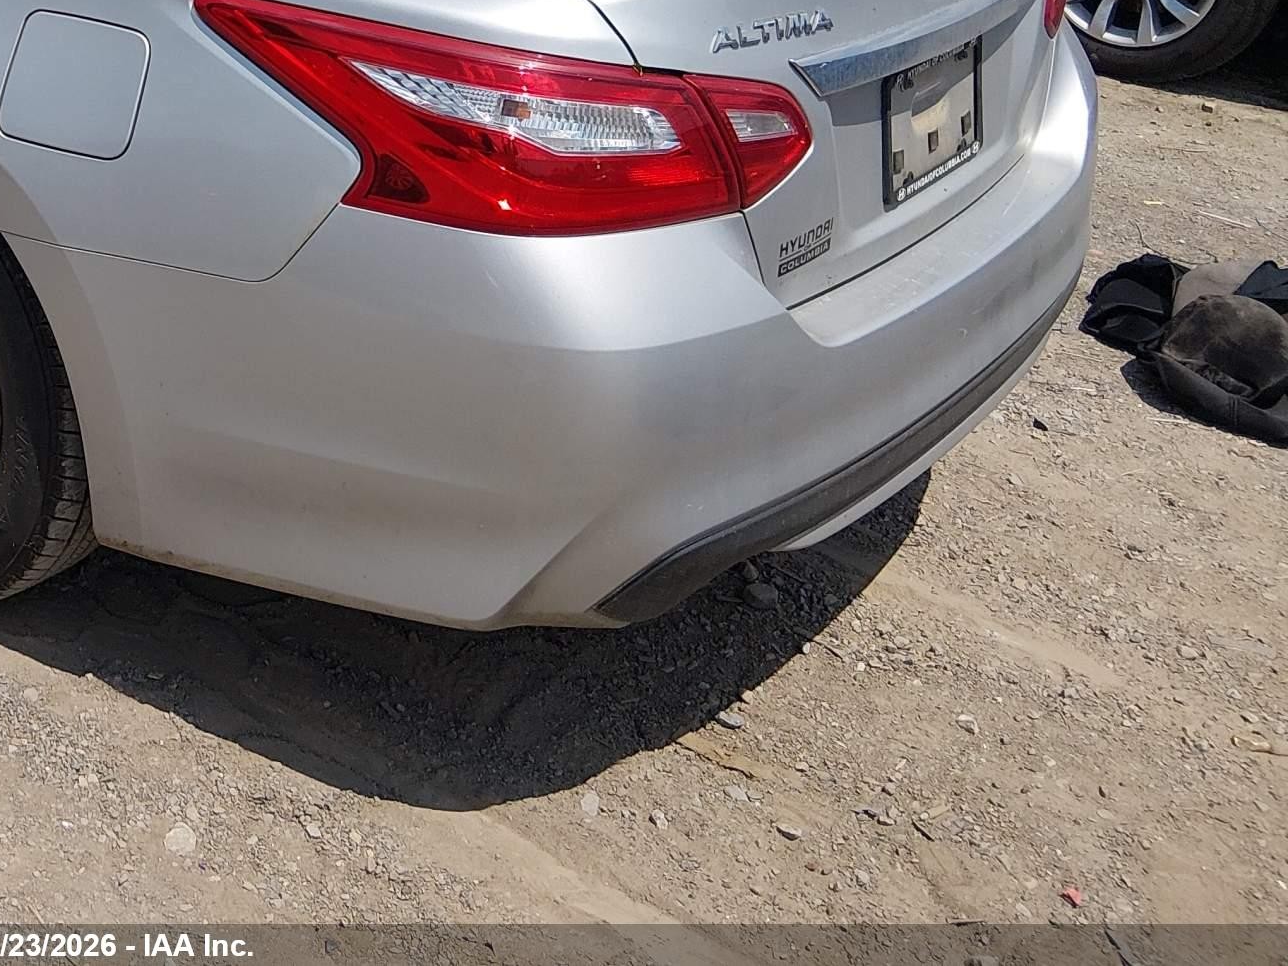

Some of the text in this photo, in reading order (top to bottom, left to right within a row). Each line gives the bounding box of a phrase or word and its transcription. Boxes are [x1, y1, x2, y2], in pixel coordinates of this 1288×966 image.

[710, 8, 834, 54] ALTIMA
[779, 217, 834, 259] HYUNDAI
[780, 241, 830, 273] COLUMBIA
